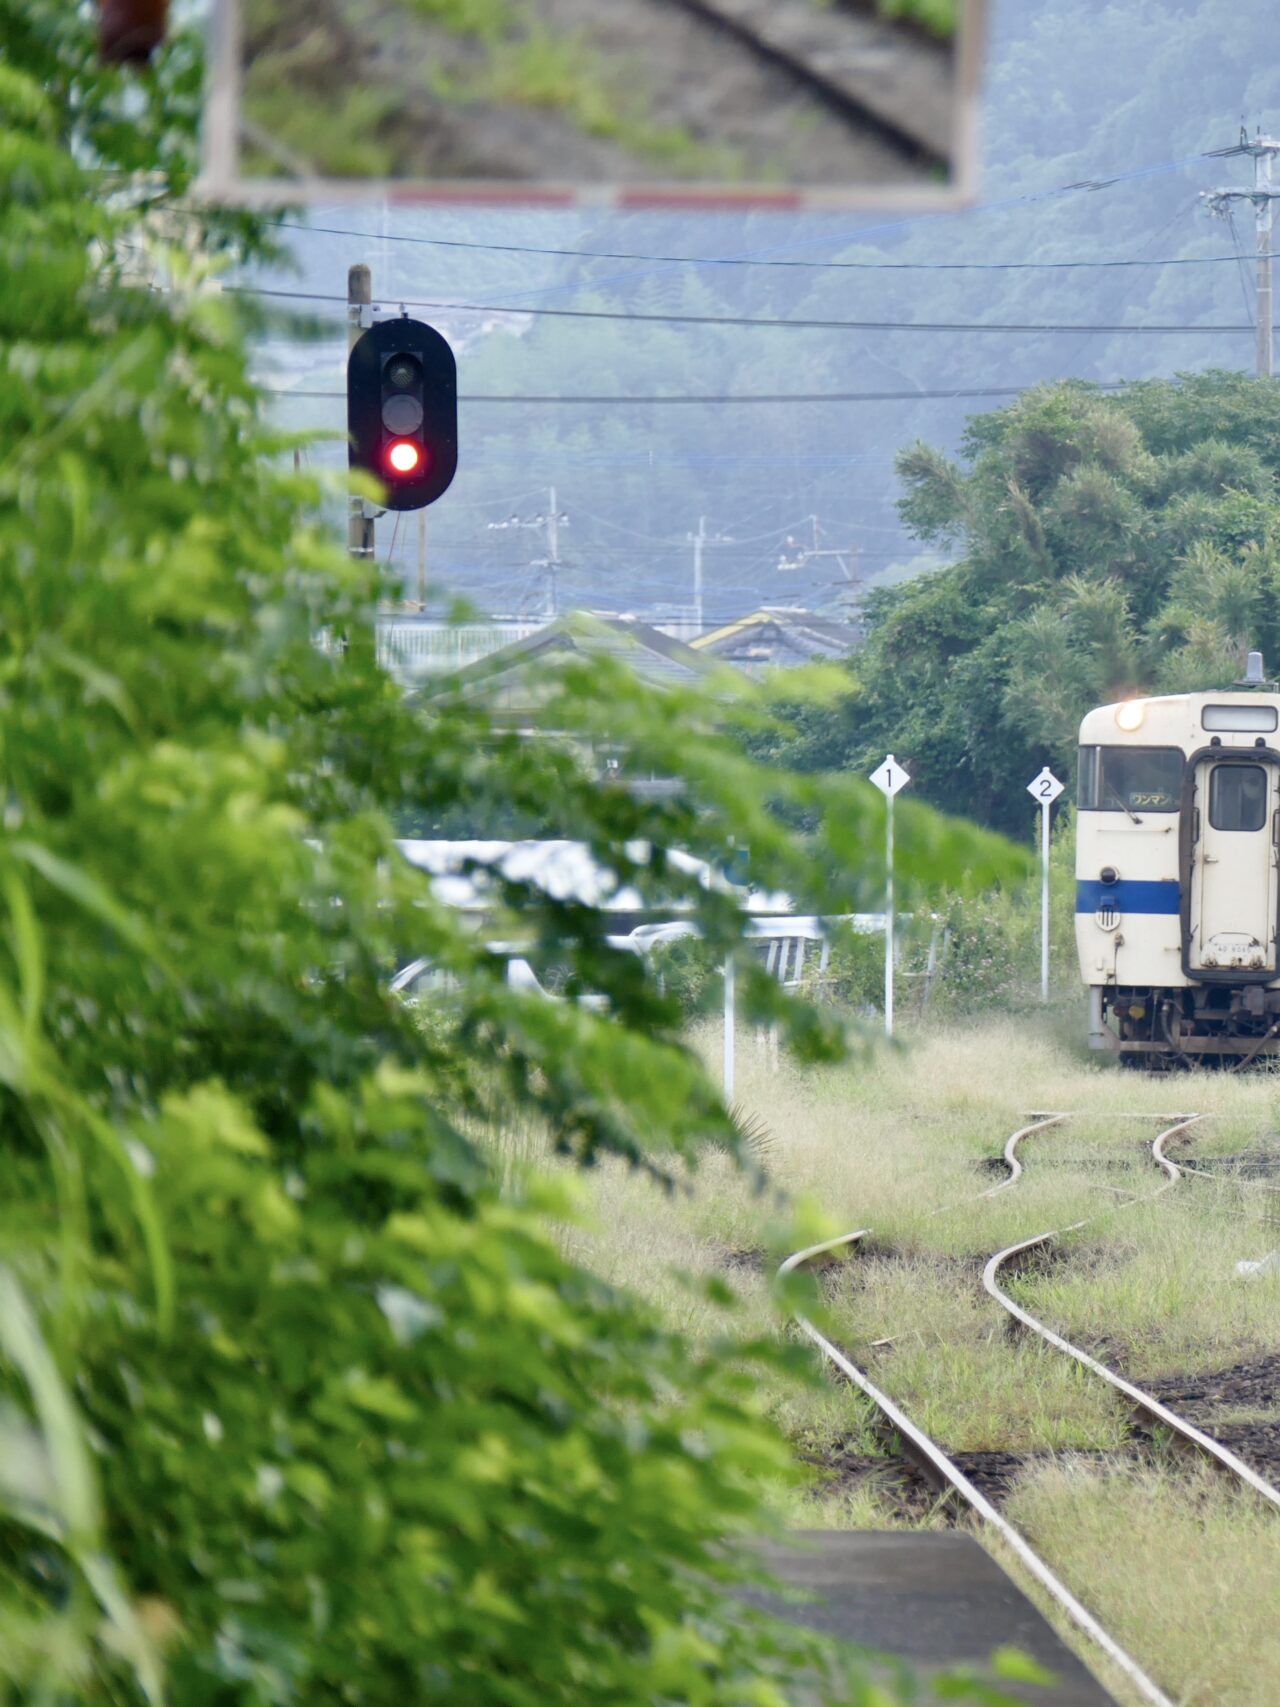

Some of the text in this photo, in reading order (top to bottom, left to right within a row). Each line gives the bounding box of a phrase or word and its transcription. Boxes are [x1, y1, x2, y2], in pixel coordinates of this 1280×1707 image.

[885, 768, 892, 788] 1
[1040, 779, 1052, 797] 2
[1133, 794, 1169, 805] ワンマン
